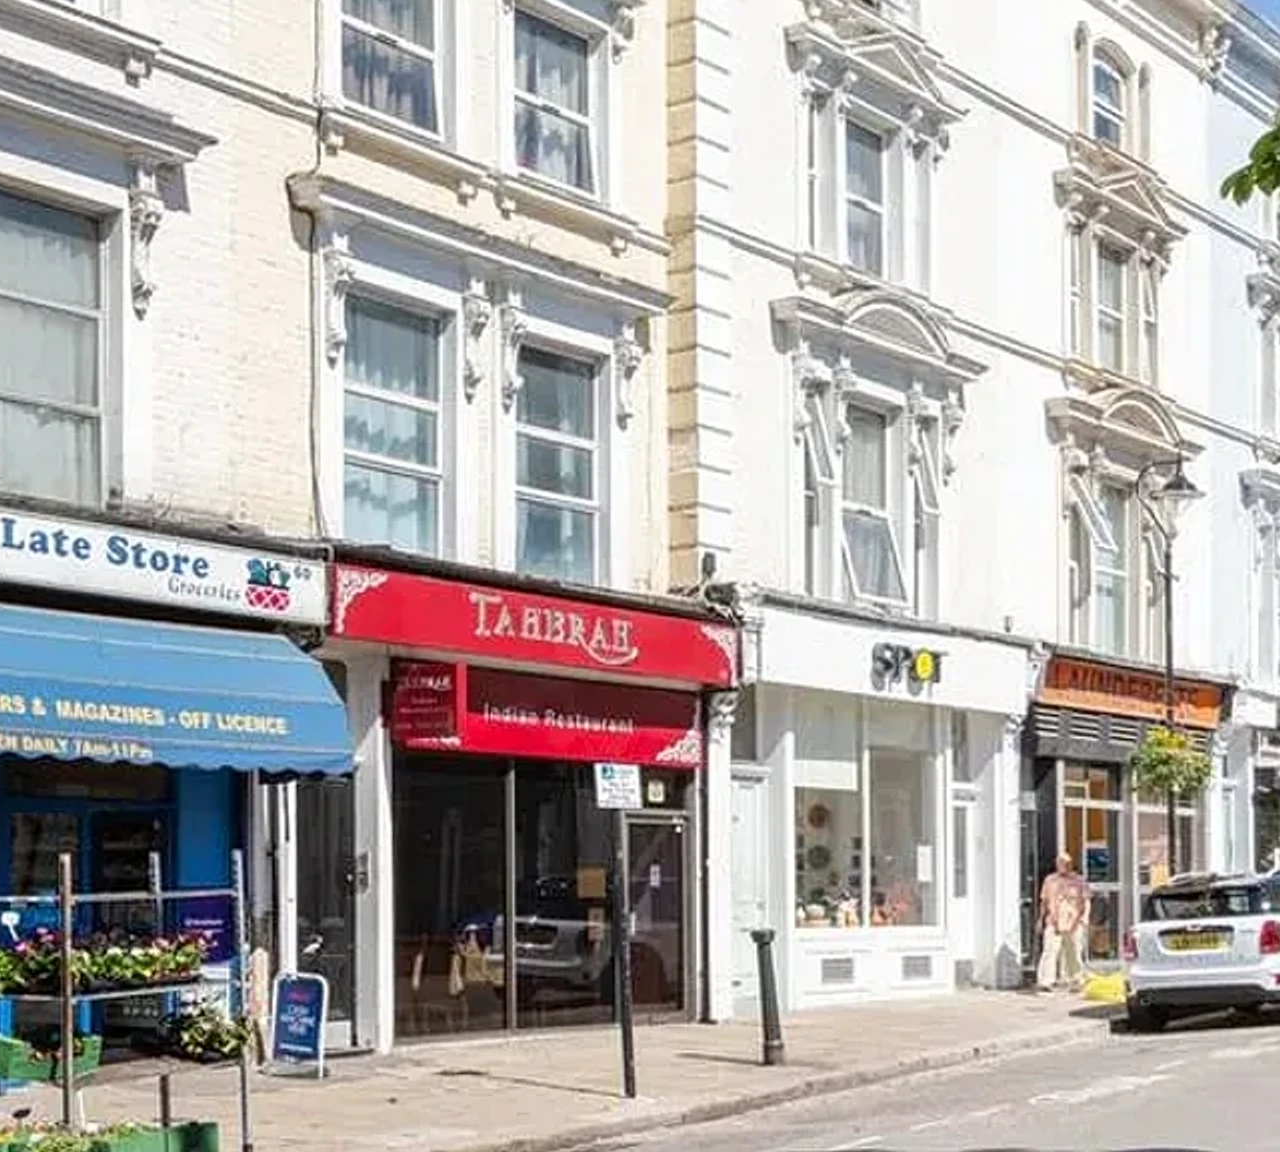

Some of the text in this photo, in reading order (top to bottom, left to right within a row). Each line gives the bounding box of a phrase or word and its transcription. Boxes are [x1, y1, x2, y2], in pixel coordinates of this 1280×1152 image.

[0, 517, 91, 560] Late
[106, 535, 210, 579] Store
[32, 697, 47, 716] &
[56, 698, 166, 728] MAGAZINES
[179, 710, 211, 730] OFF
[216, 715, 292, 736] LICENCE
[484, 703, 635, 734] Indian Restaurant
[22, 735, 69, 754] DAILY
